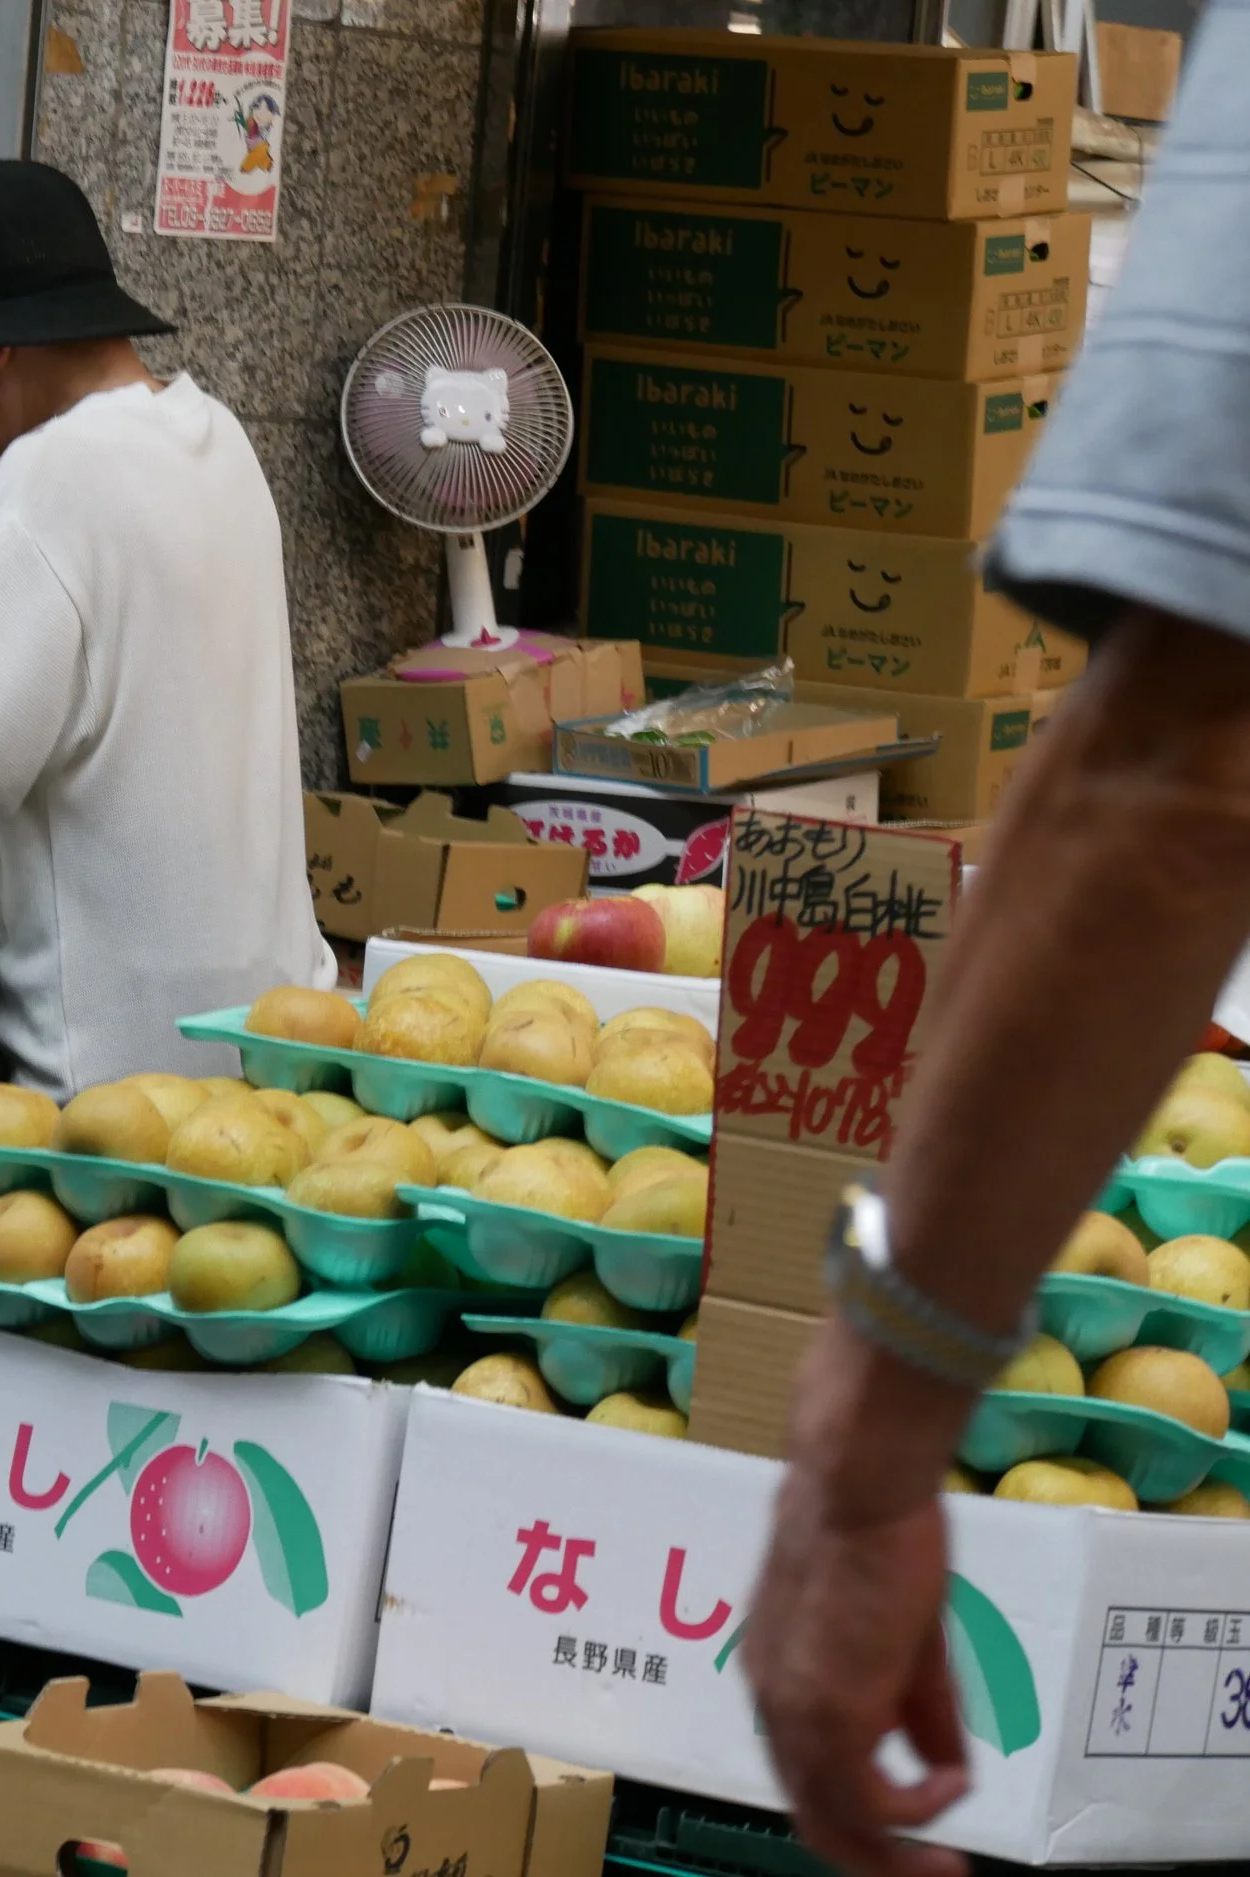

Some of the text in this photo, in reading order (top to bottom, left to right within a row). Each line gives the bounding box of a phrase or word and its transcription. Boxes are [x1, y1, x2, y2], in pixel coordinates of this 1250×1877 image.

[618, 60, 721, 94] Ibaraki
[811, 171, 894, 199] ピーマン
[633, 218, 734, 256] Ibaraki
[826, 334, 909, 363] ピーマン
[635, 373, 738, 411] Ibaraki
[830, 490, 913, 519] ピーマン
[635, 528, 737, 567] Ibaraki
[826, 646, 910, 676] ピーマン
[734, 811, 868, 871] あおもり
[730, 858, 948, 940] 川中島白桃
[507, 1520, 733, 1641] なし
[552, 1634, 669, 1685] 長野県産
